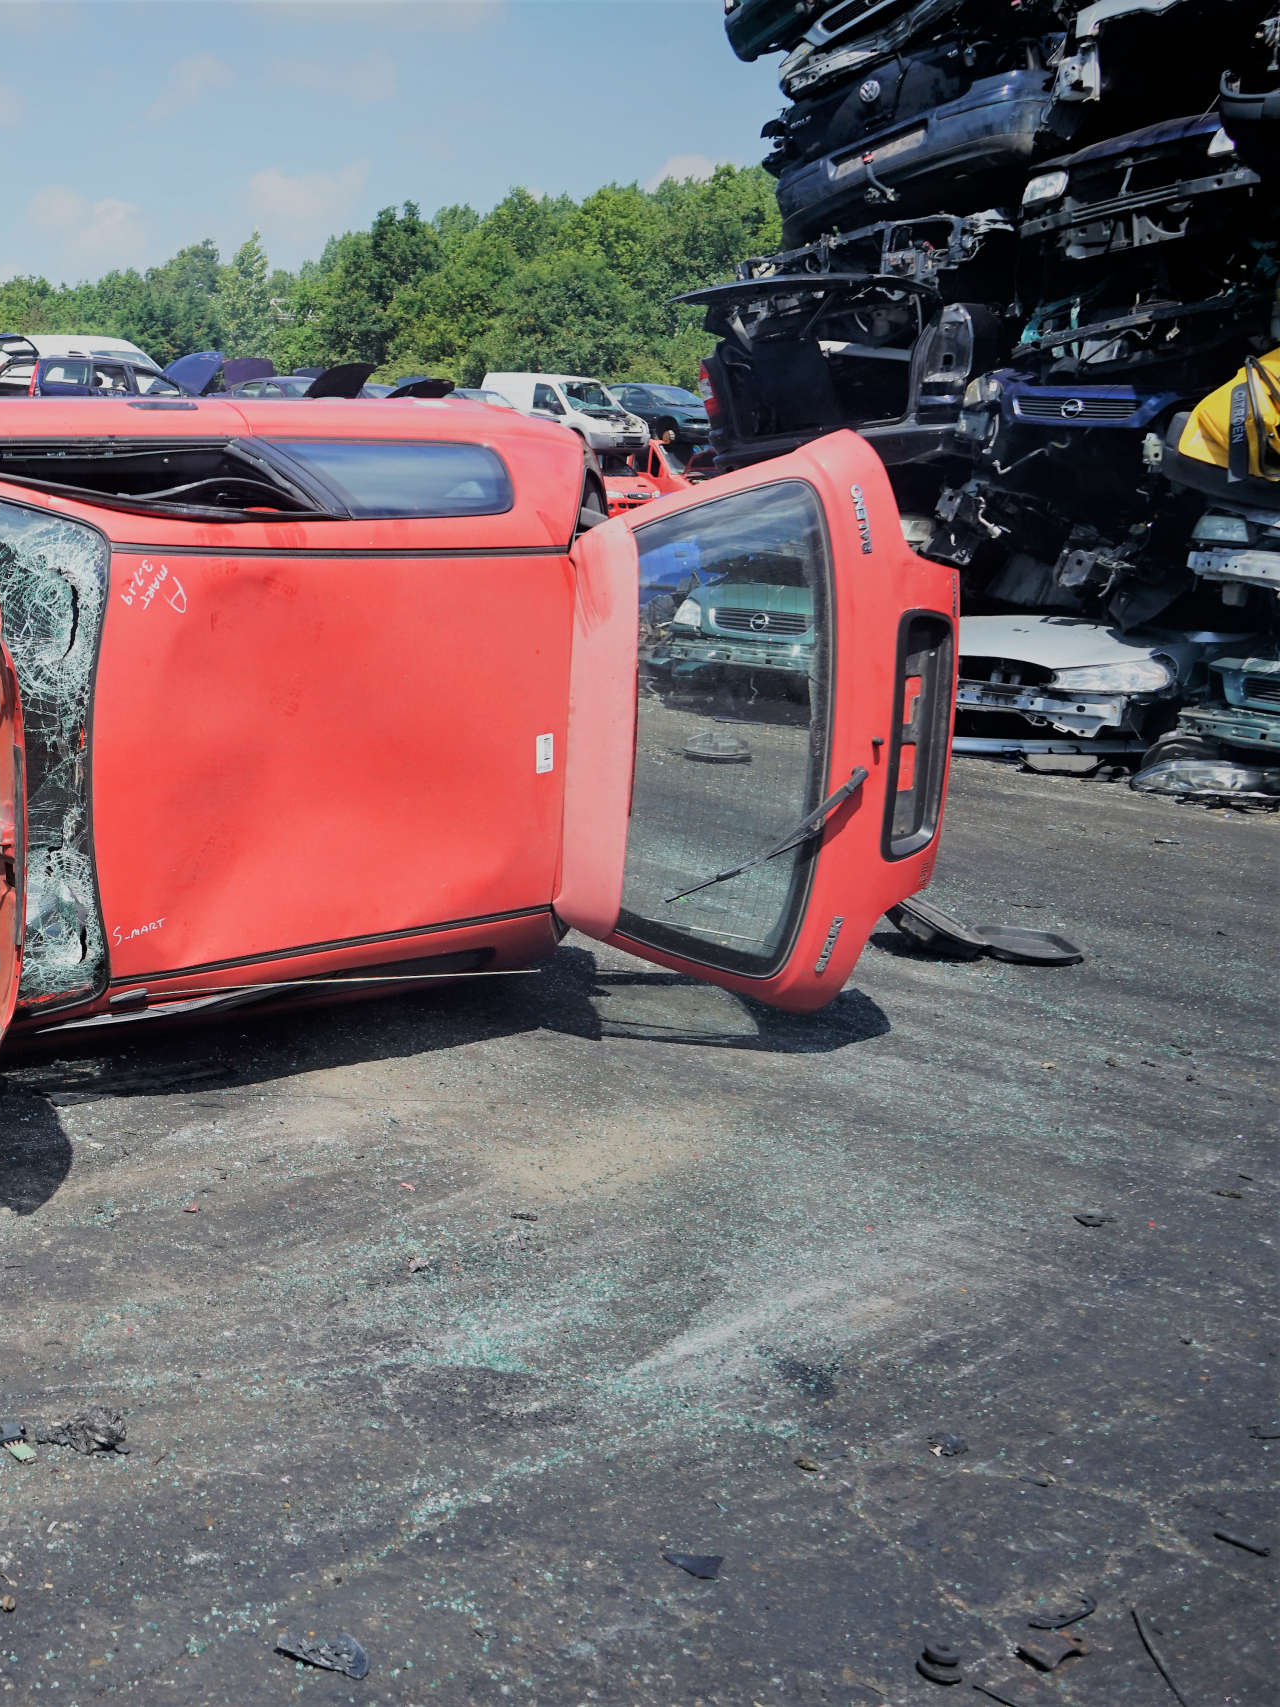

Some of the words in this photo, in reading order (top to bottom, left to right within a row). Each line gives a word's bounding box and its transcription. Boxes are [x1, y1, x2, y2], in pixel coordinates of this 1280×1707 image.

[1231, 390, 1247, 444] CITROËN
[850, 484, 873, 554] BALENO
[814, 915, 845, 973] SUZUKI
